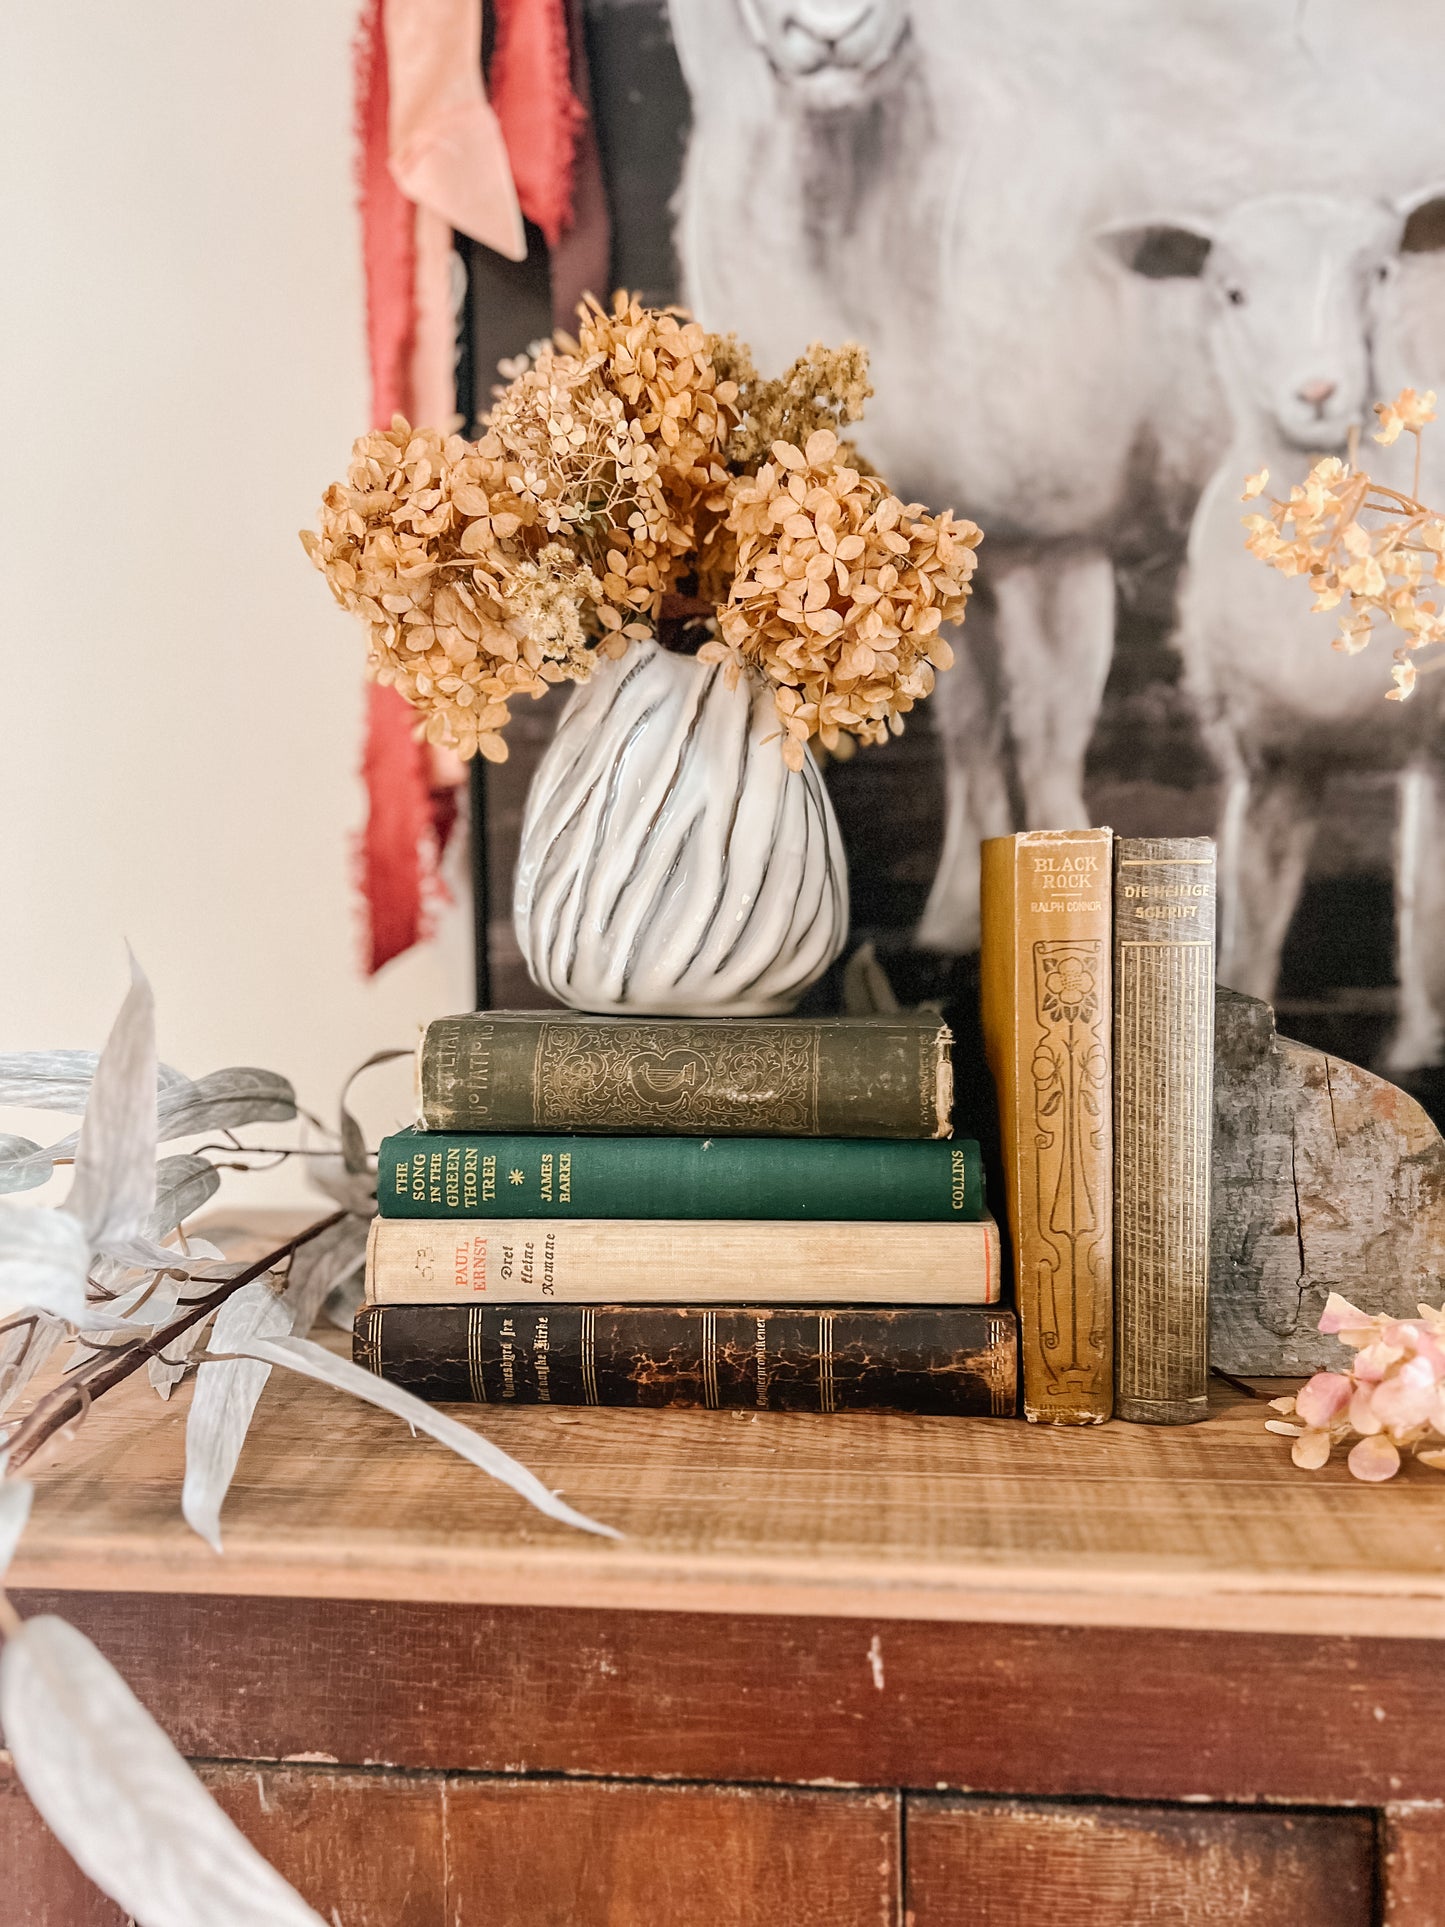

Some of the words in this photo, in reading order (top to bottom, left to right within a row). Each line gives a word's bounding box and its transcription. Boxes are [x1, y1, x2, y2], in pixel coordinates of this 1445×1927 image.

[1034, 856, 1099, 873] BLACK
[1042, 872, 1093, 889] ROCK
[1031, 901, 1064, 913] RALPH
[1066, 900, 1102, 912] CONNOR
[1124, 886, 1150, 898] DIE
[1152, 884, 1210, 898] HEILIGE
[1135, 905, 1198, 920] SCHRIFT
[467, 1024, 494, 1125] UOTATIONS
[396, 1162, 408, 1194] THE
[412, 1154, 426, 1200] SONG
[430, 1153, 442, 1185] THE
[446, 1148, 461, 1207] GREEN
[464, 1147, 479, 1208] THORN
[482, 1155, 496, 1201] TREE
[540, 1154, 553, 1201] JAMES
[559, 1152, 571, 1203] BARKE
[952, 1150, 965, 1210] COLLINS
[430, 1188, 442, 1203] IN
[455, 1241, 469, 1286] PAUL
[473, 1236, 488, 1291] ERNST
[542, 1233, 556, 1296] Romane
